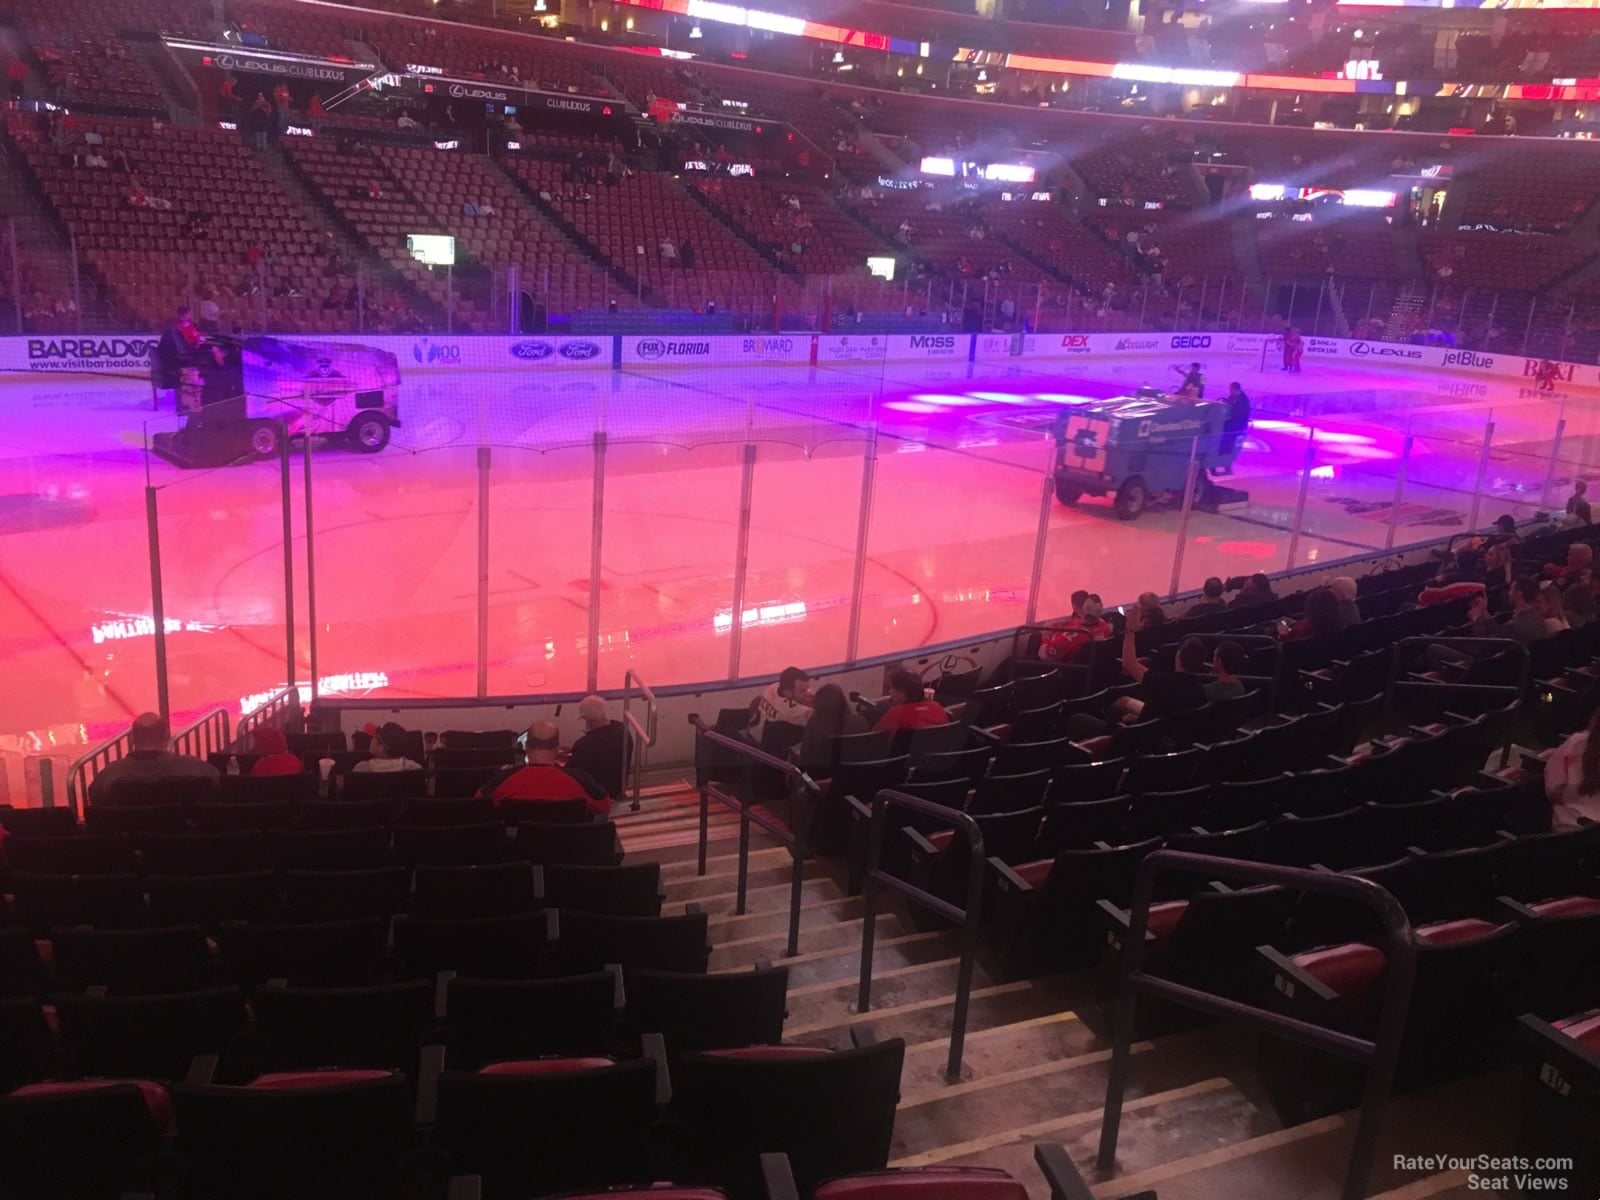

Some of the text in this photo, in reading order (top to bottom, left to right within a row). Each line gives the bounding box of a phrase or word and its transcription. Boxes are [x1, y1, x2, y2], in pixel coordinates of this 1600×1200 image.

[235, 59, 287, 73] LEXUS
[464, 89, 507, 101] LEXUS
[642, 342, 660, 352] FOX
[1061, 335, 1089, 347] DEX
[1170, 335, 1212, 349] GEICO
[518, 343, 547, 357] Ford
[566, 343, 593, 357] Ford
[667, 342, 710, 355] FLORIDA
[1371, 347, 1423, 359] LEXUS
[30, 358, 150, 369] www.visitbarbados.o
[1441, 349, 1494, 369] jetBlue
